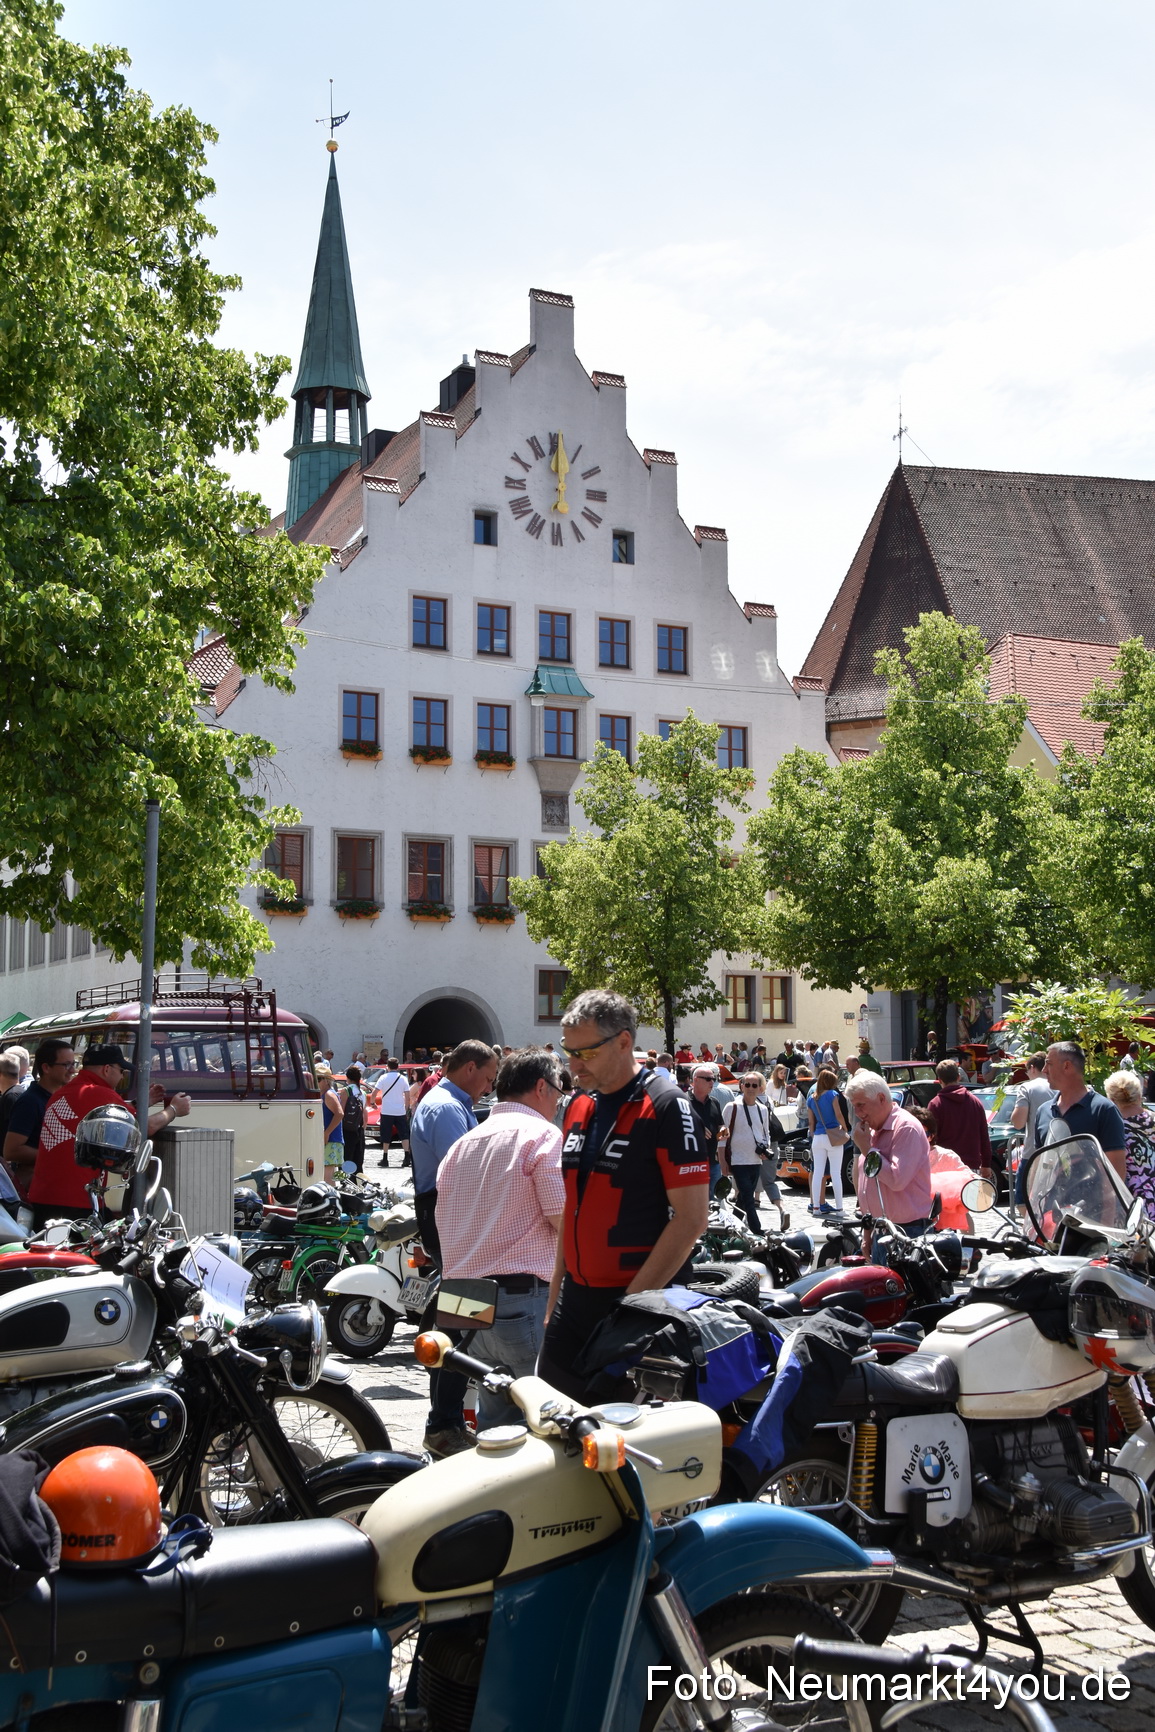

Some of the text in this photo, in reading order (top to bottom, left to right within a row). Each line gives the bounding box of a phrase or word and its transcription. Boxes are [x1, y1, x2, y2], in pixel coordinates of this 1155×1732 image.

[526, 435, 546, 460] XI
[548, 432, 563, 455] XI
[571, 444, 582, 464] I
[511, 452, 532, 472] X
[581, 466, 601, 480] II
[505, 476, 526, 490] IX
[586, 489, 607, 502] III
[509, 495, 534, 520] VIII
[581, 506, 603, 528] IV
[526, 512, 546, 539] VII
[552, 522, 563, 546] VI
[571, 520, 585, 543] V
[676, 1097, 698, 1152] BMC
[679, 1164, 708, 1175] BMC
[410, 1280, 417, 1290] N
[901, 1444, 921, 1484] Marie
[938, 1440, 960, 1480] Marie
[528, 1516, 602, 1539] Trophy
